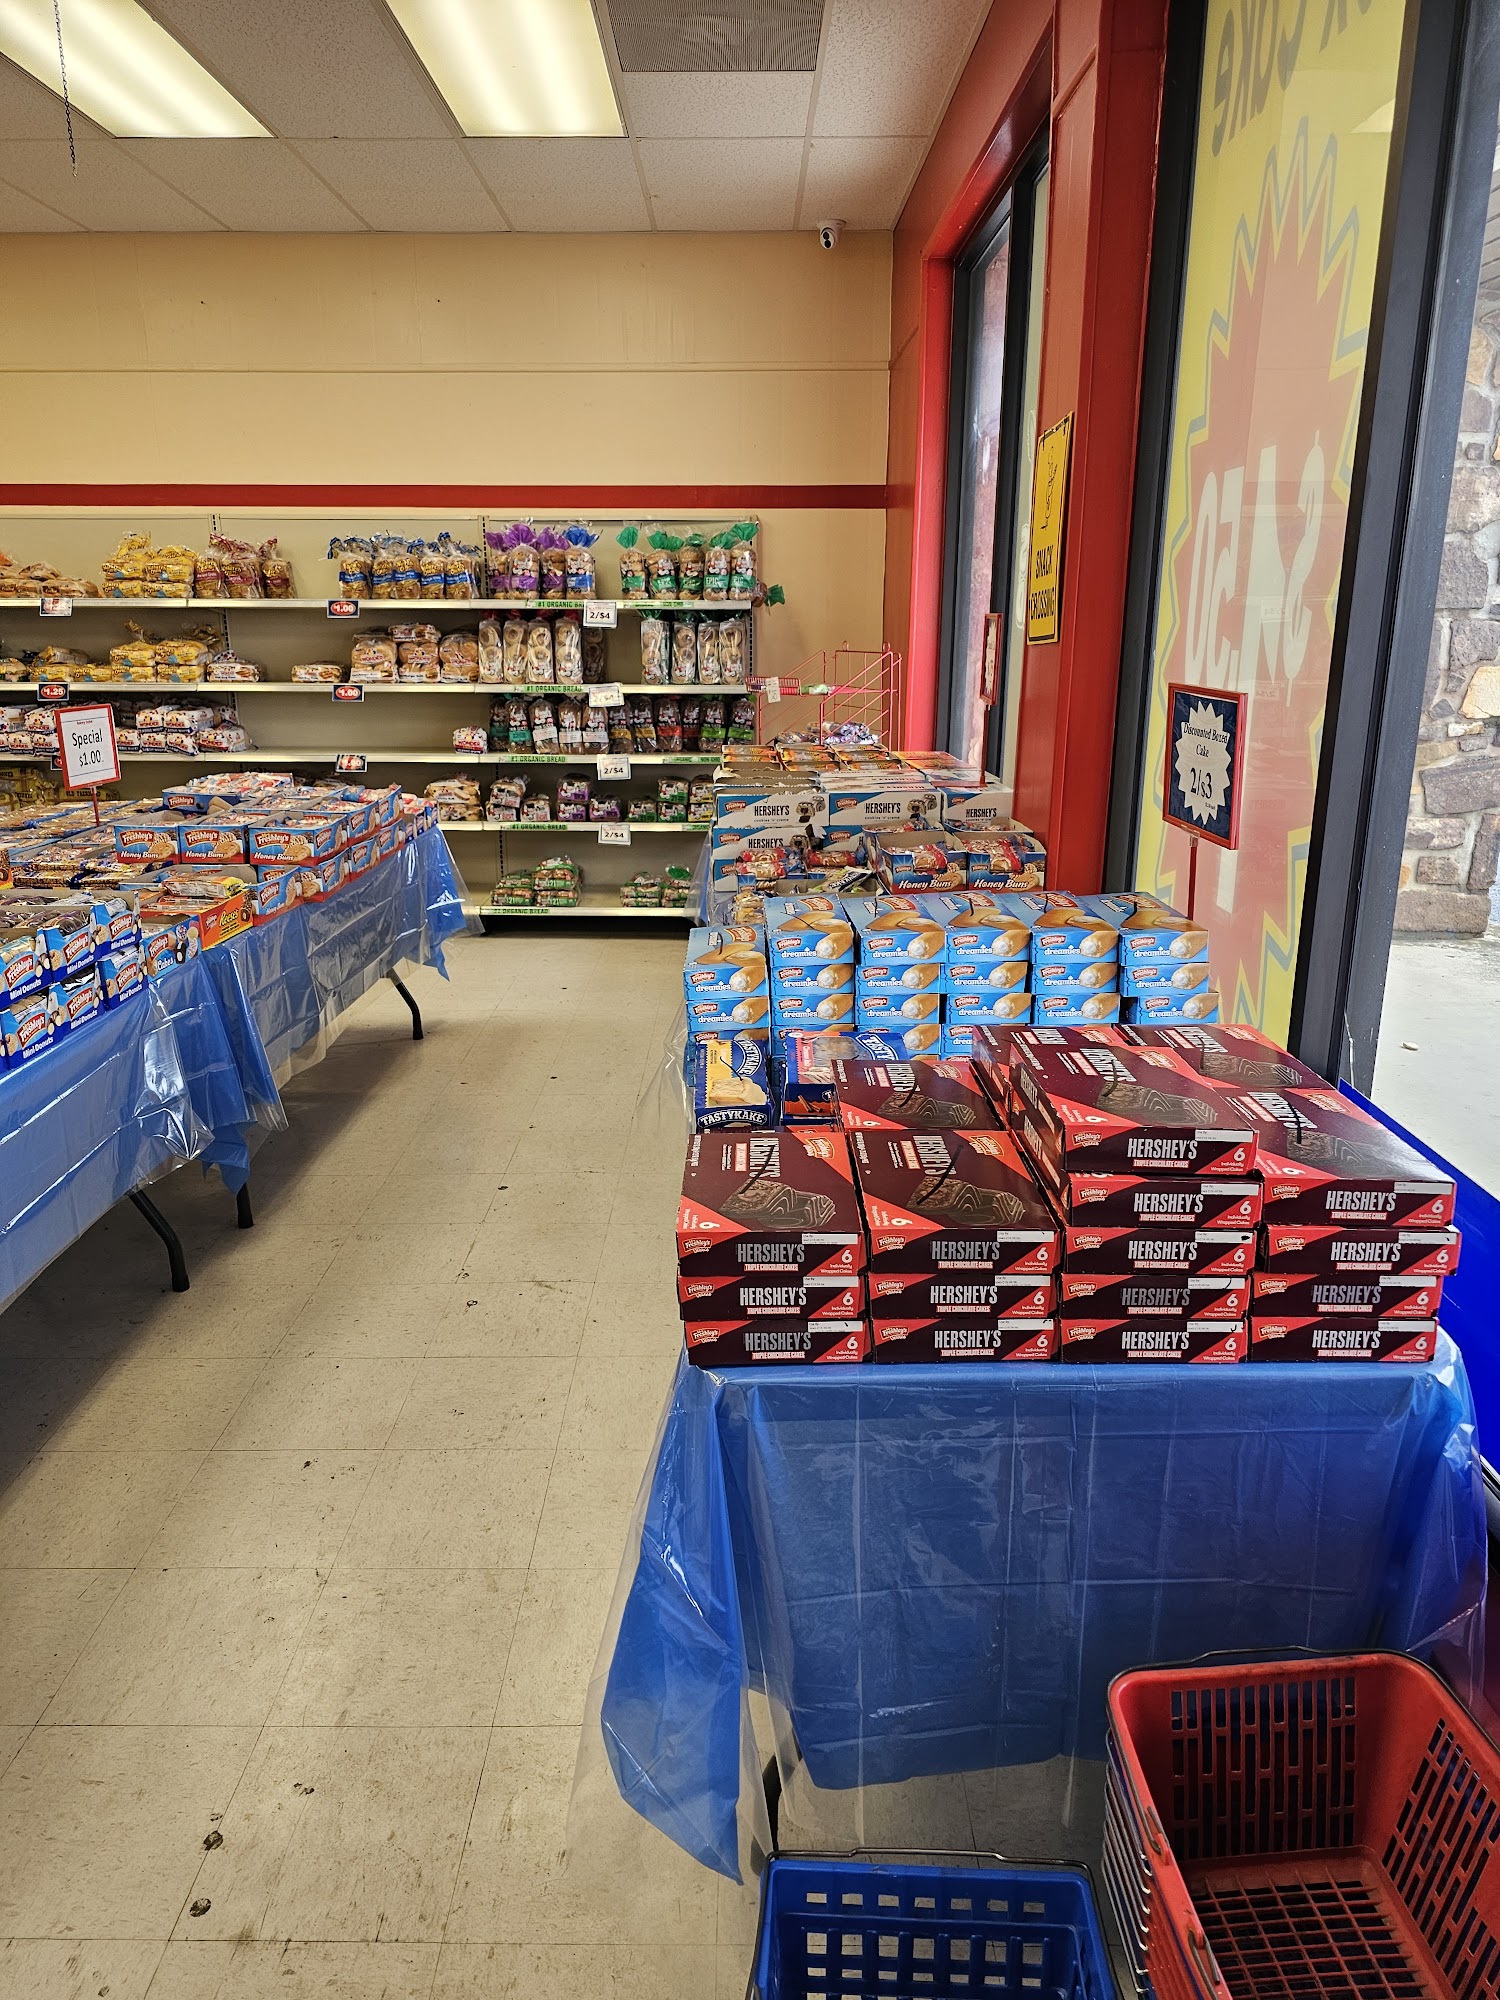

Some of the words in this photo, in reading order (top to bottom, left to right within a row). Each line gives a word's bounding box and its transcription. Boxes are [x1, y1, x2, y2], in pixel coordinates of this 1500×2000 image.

[333, 604, 354, 613] $1.00
[338, 689, 358, 697] $1.00
[72, 728, 103, 748] Special
[1184, 723, 1211, 740] Discounted
[1211, 729, 1228, 744] Boxed
[1196, 744, 1209, 758] Cake
[79, 750, 101, 767] $1.00
[754, 806, 789, 816] HERSHEY'S
[865, 803, 900, 813] HERSHEY'S
[966, 808, 997, 818] HERSHEY'S
[121, 832, 153, 842] Freshley's
[187, 831, 218, 841] Freshley's
[258, 833, 289, 844] Freshley's
[749, 839, 783, 848] HERSHEY'S
[121, 851, 141, 859] Honey
[186, 851, 206, 859] Honey
[254, 853, 275, 861] Honey
[899, 880, 928, 889] Honey
[930, 879, 951, 888] Buns
[974, 879, 1004, 888] Honey
[1006, 879, 1029, 888] Buns
[111, 939, 120, 949] Mini
[121, 935, 135, 946] Donuts
[782, 949, 817, 958] dreamies
[873, 950, 908, 958] dreamies
[957, 946, 993, 955] dreamies
[1044, 947, 1080, 955] dreamies
[1134, 948, 1170, 957] dreamies
[67, 965, 77, 974] Mini
[78, 954, 94, 970] Donuts
[696, 983, 731, 992] dreamies
[783, 979, 817, 988] dreamies
[867, 979, 902, 987] dreamies
[954, 978, 989, 986] dreamies
[1044, 978, 1080, 986] dreamies
[1136, 979, 1172, 988] dreamies
[10, 988, 22, 1000] Mini
[22, 979, 41, 996] Donuts
[120, 992, 128, 1001] Mini
[128, 983, 142, 997] Donuts
[698, 1014, 733, 1023] dreamies
[782, 1010, 817, 1018] dreamies
[867, 1009, 902, 1018] dreamies
[959, 1008, 993, 1017] dreamies
[1047, 1008, 1082, 1017] dreamies
[1149, 1009, 1183, 1018] dreamies
[71, 1020, 81, 1029] Mini
[82, 1010, 97, 1025] Donuts
[23, 1047, 35, 1058] Mini
[35, 1037, 53, 1053] Donuts
[700, 1110, 765, 1125] TASTYKAKE
[1127, 1138, 1197, 1159] HERSHEY'S
[1233, 1148, 1245, 1161] 6
[1134, 1193, 1203, 1213] HERSHEY'S
[1240, 1201, 1251, 1214] 6
[1326, 1191, 1396, 1212] HERSHEY'S
[1432, 1200, 1444, 1213] 6
[737, 1244, 805, 1262] HERSHEY'S
[842, 1250, 852, 1263] 6
[932, 1241, 1000, 1260] HERSHEY'S
[1037, 1247, 1048, 1260] 6
[1128, 1241, 1197, 1260] HERSHEY'S
[1233, 1249, 1245, 1262] 6
[1331, 1242, 1401, 1262] HERSHEY'S
[1436, 1250, 1449, 1263] 6
[740, 1287, 807, 1306] HERSHEY'S
[843, 1293, 854, 1305] 6
[930, 1286, 997, 1304] HERSHEY'S
[1034, 1292, 1044, 1305] 6
[1121, 1288, 1191, 1306] HERSHEY'S
[1226, 1294, 1238, 1307] 6
[1312, 1285, 1382, 1303] HERSHEY'S
[1417, 1292, 1429, 1305] 6
[744, 1332, 811, 1351] HERSHEY'S
[847, 1336, 858, 1349] 6
[935, 1330, 1001, 1348] HERSHEY'S
[1037, 1335, 1048, 1348] 6
[1122, 1332, 1189, 1350] HERSHEY'S
[1225, 1338, 1236, 1350] 6
[1312, 1330, 1381, 1349] HERSHEY'S
[1415, 1337, 1427, 1350] 6
